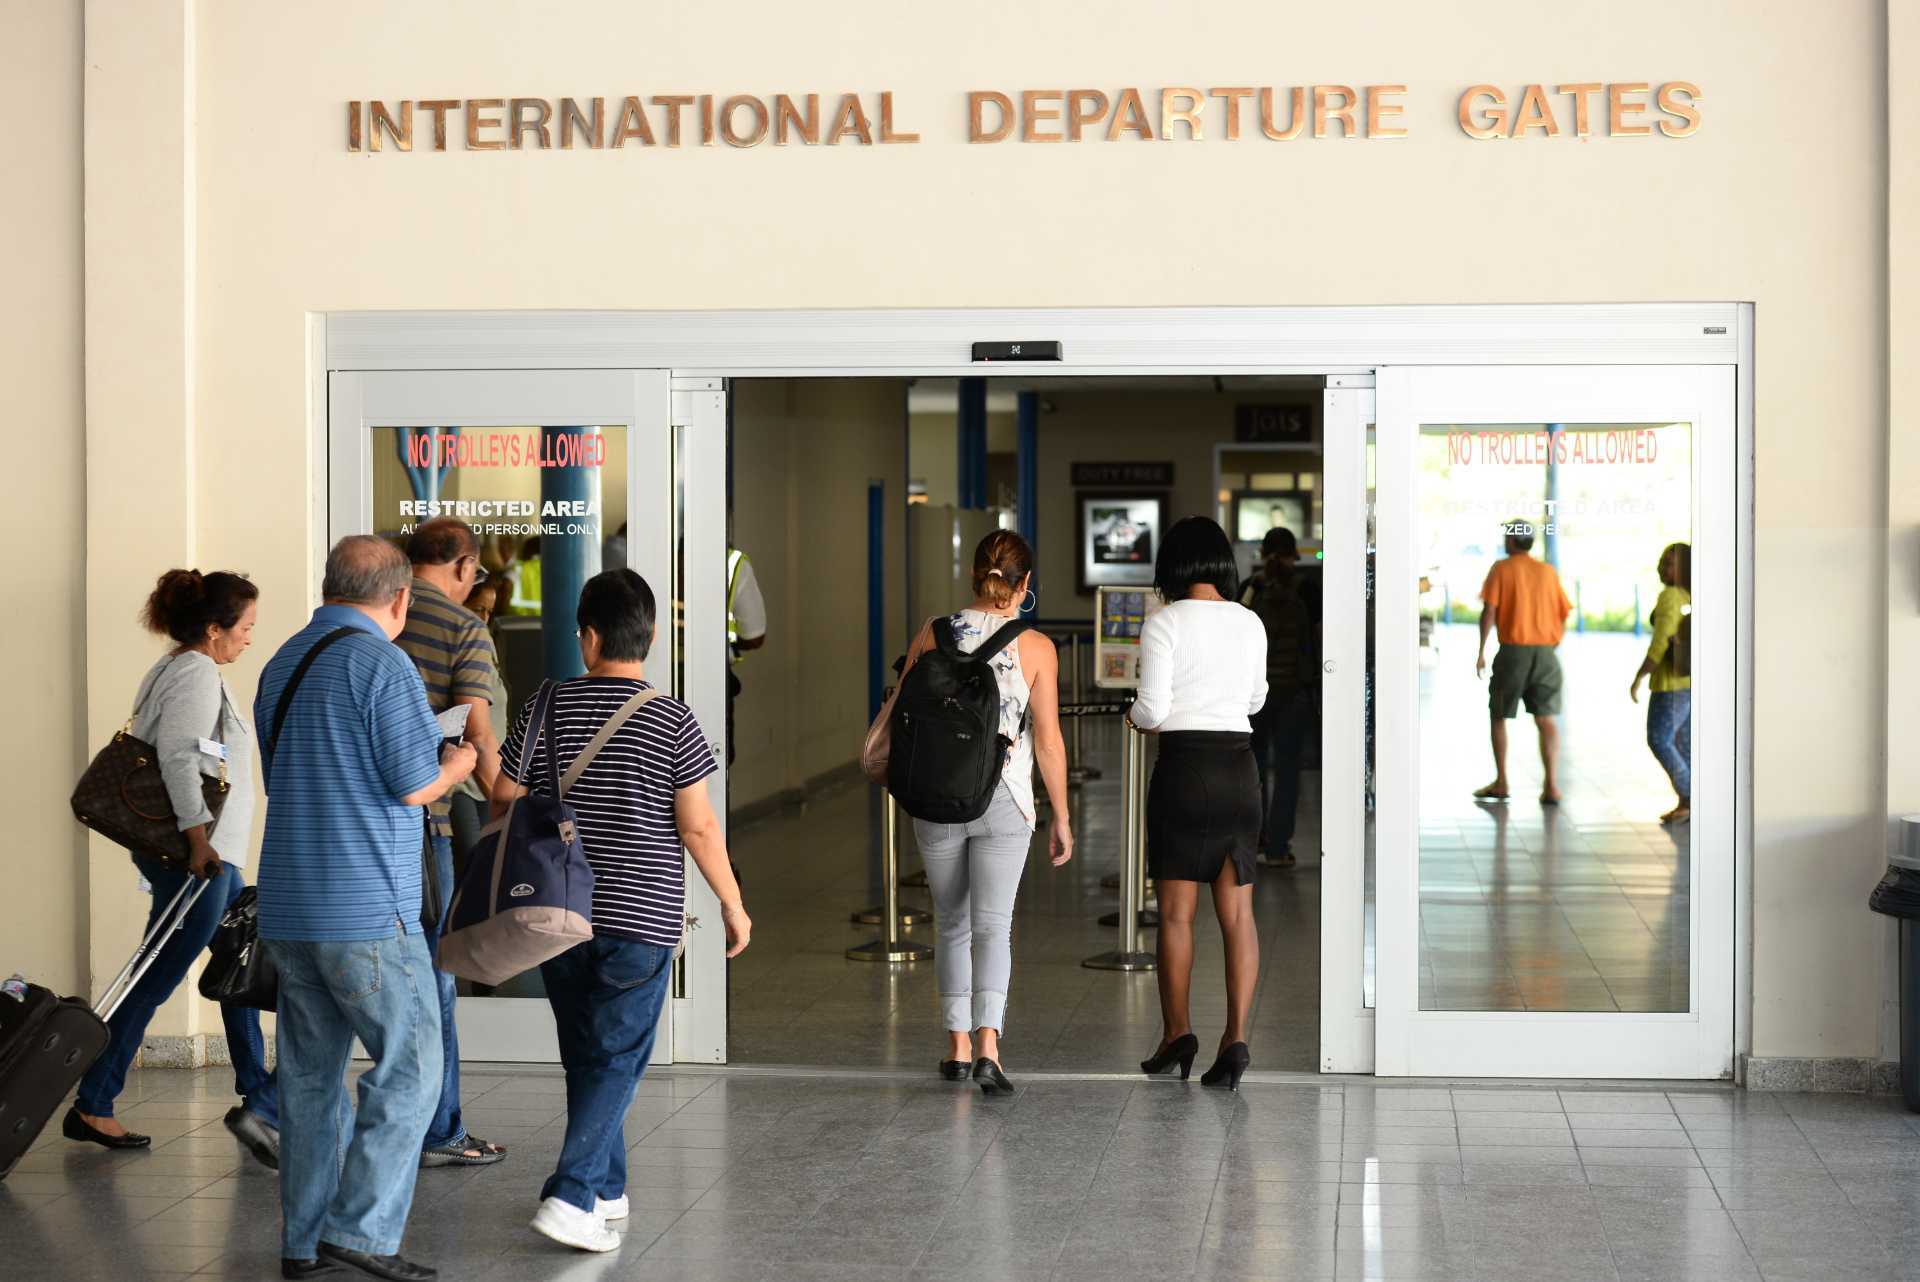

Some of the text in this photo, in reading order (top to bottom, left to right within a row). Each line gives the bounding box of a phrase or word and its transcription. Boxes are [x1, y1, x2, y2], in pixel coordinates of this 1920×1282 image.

[348, 81, 1703, 152] INTERNATIONAL DEPARTURE GATES
[407, 431, 606, 468] NO TROLLEYS ALLOWED
[1448, 430, 1658, 465] NO TROLLEYS ALLOWED
[399, 500, 535, 517] RESTRICTED
[485, 523, 564, 536] PERSONNEL
